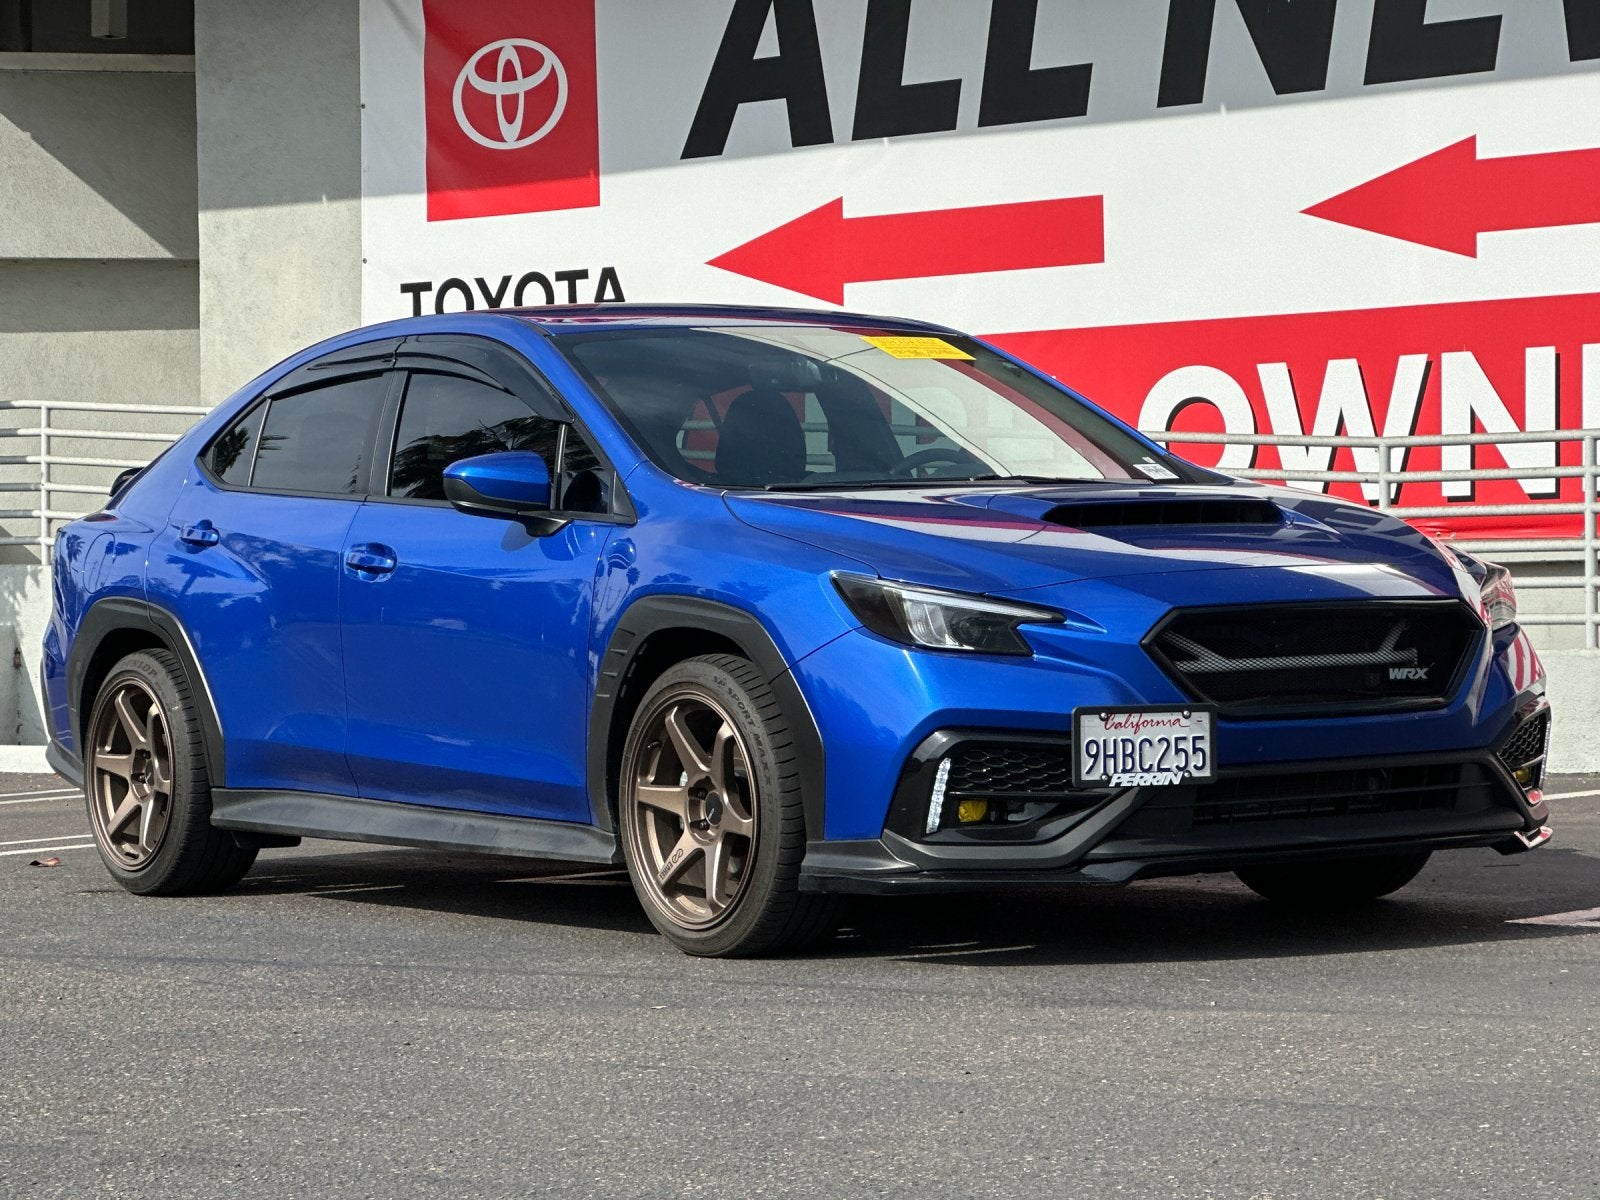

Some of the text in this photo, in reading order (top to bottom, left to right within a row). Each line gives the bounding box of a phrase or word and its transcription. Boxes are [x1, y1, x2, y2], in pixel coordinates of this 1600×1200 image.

[680, 0, 1094, 160] ALL
[400, 266, 626, 317] TOYOTA
[1137, 343, 1600, 507] OWN
[1389, 667, 1430, 680] WRX
[727, 687, 757, 726] SPORT
[1103, 712, 1190, 735] California
[1085, 735, 1207, 775] 9HBC255
[1109, 771, 1184, 787] PERRIN
